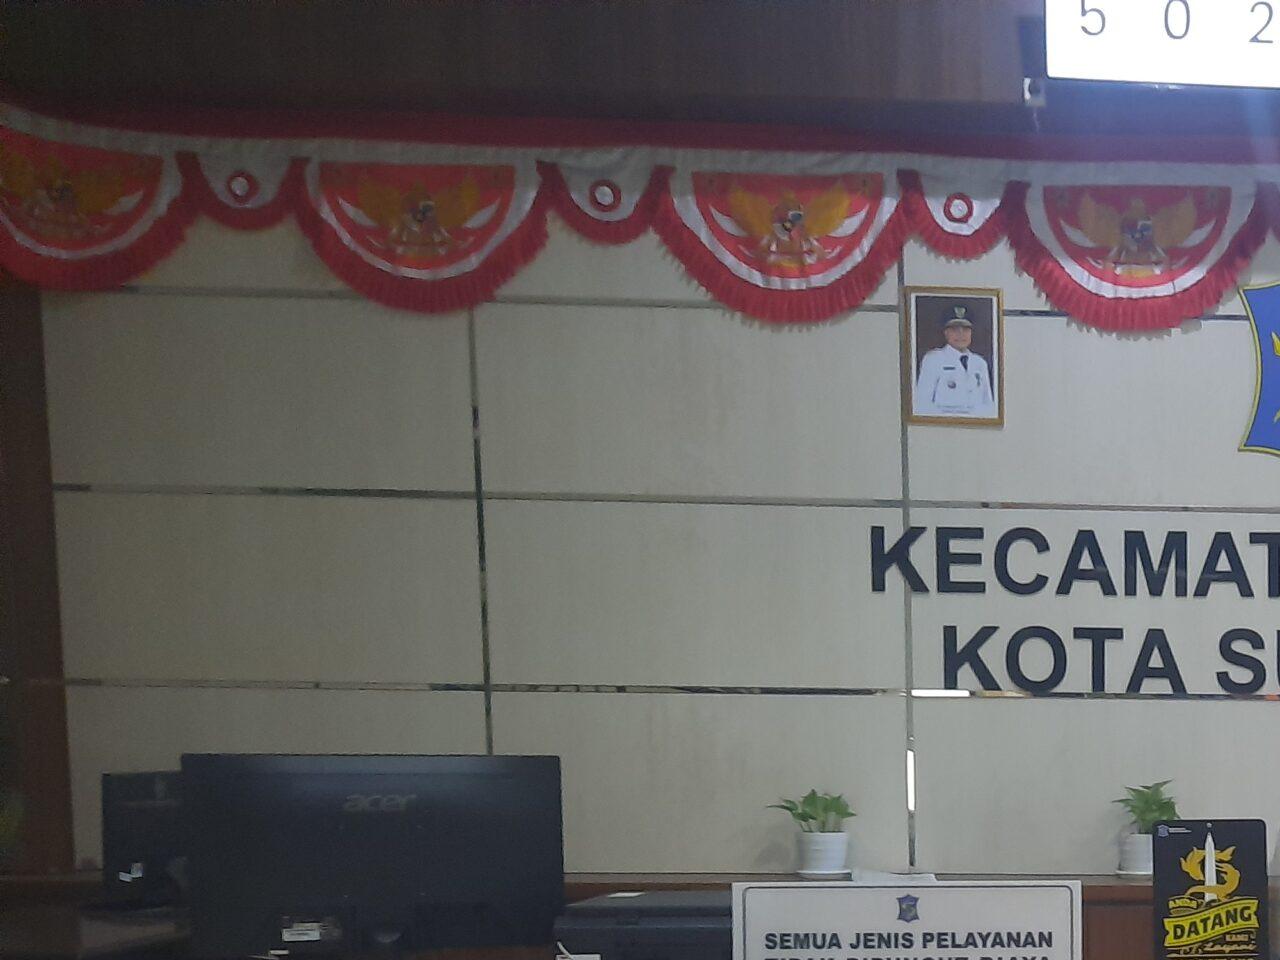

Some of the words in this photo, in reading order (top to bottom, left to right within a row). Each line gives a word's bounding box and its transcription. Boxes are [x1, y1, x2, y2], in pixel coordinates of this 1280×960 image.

[1164, 0, 1191, 40] 0
[1249, 1, 1274, 44] 2
[942, 624, 1186, 696] KOTA
[342, 793, 418, 813] acer
[1172, 905, 1252, 940] DATANG
[764, 931, 842, 951] SEMUA
[849, 932, 914, 950] JENIS
[922, 931, 1053, 950] PELAYANAN
